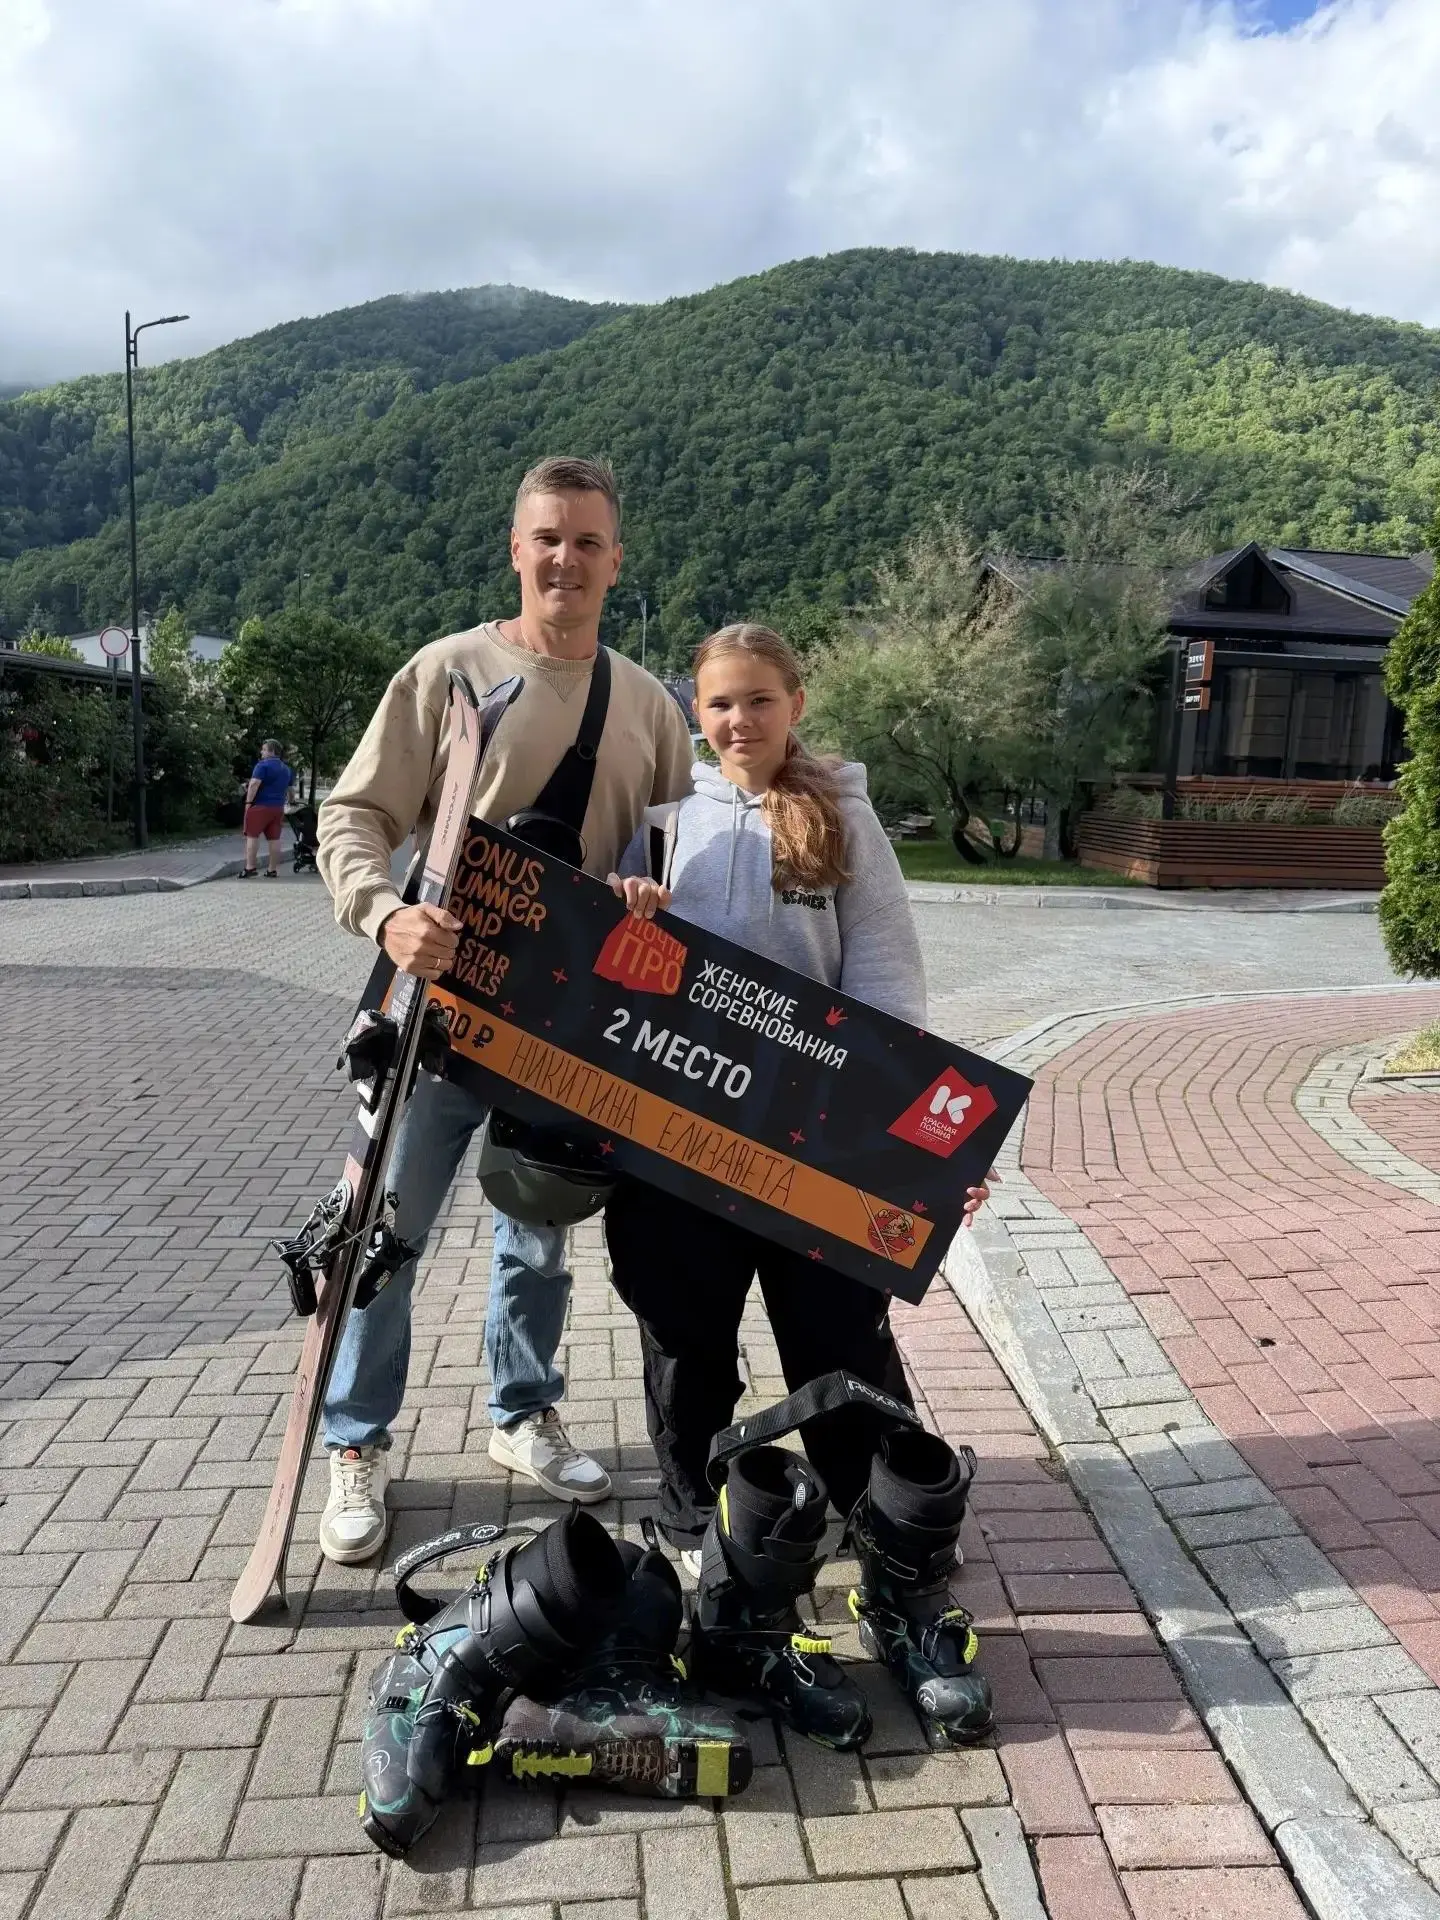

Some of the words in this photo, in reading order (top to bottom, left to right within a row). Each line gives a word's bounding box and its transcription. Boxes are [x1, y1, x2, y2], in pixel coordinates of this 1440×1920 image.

[464, 828, 545, 896] ONUS
[449, 896, 503, 939] AMP
[627, 914, 688, 968] ПОЧТИ
[461, 938, 510, 978] STAR
[611, 931, 682, 994] ПРО
[696, 959, 799, 1021] ЖЕНСКИЕ
[602, 1007, 631, 1044] 2
[631, 1019, 752, 1100] МЕСТО
[688, 982, 849, 1070] СОРЕВНОВАНИЯ
[507, 1034, 639, 1136] НИКИТИНА
[656, 1111, 796, 1207] ЕЛИЗАВЕТА
[919, 1121, 951, 1141] ПОЛЯНА
[922, 1115, 957, 1136] КРАСНАЯ
